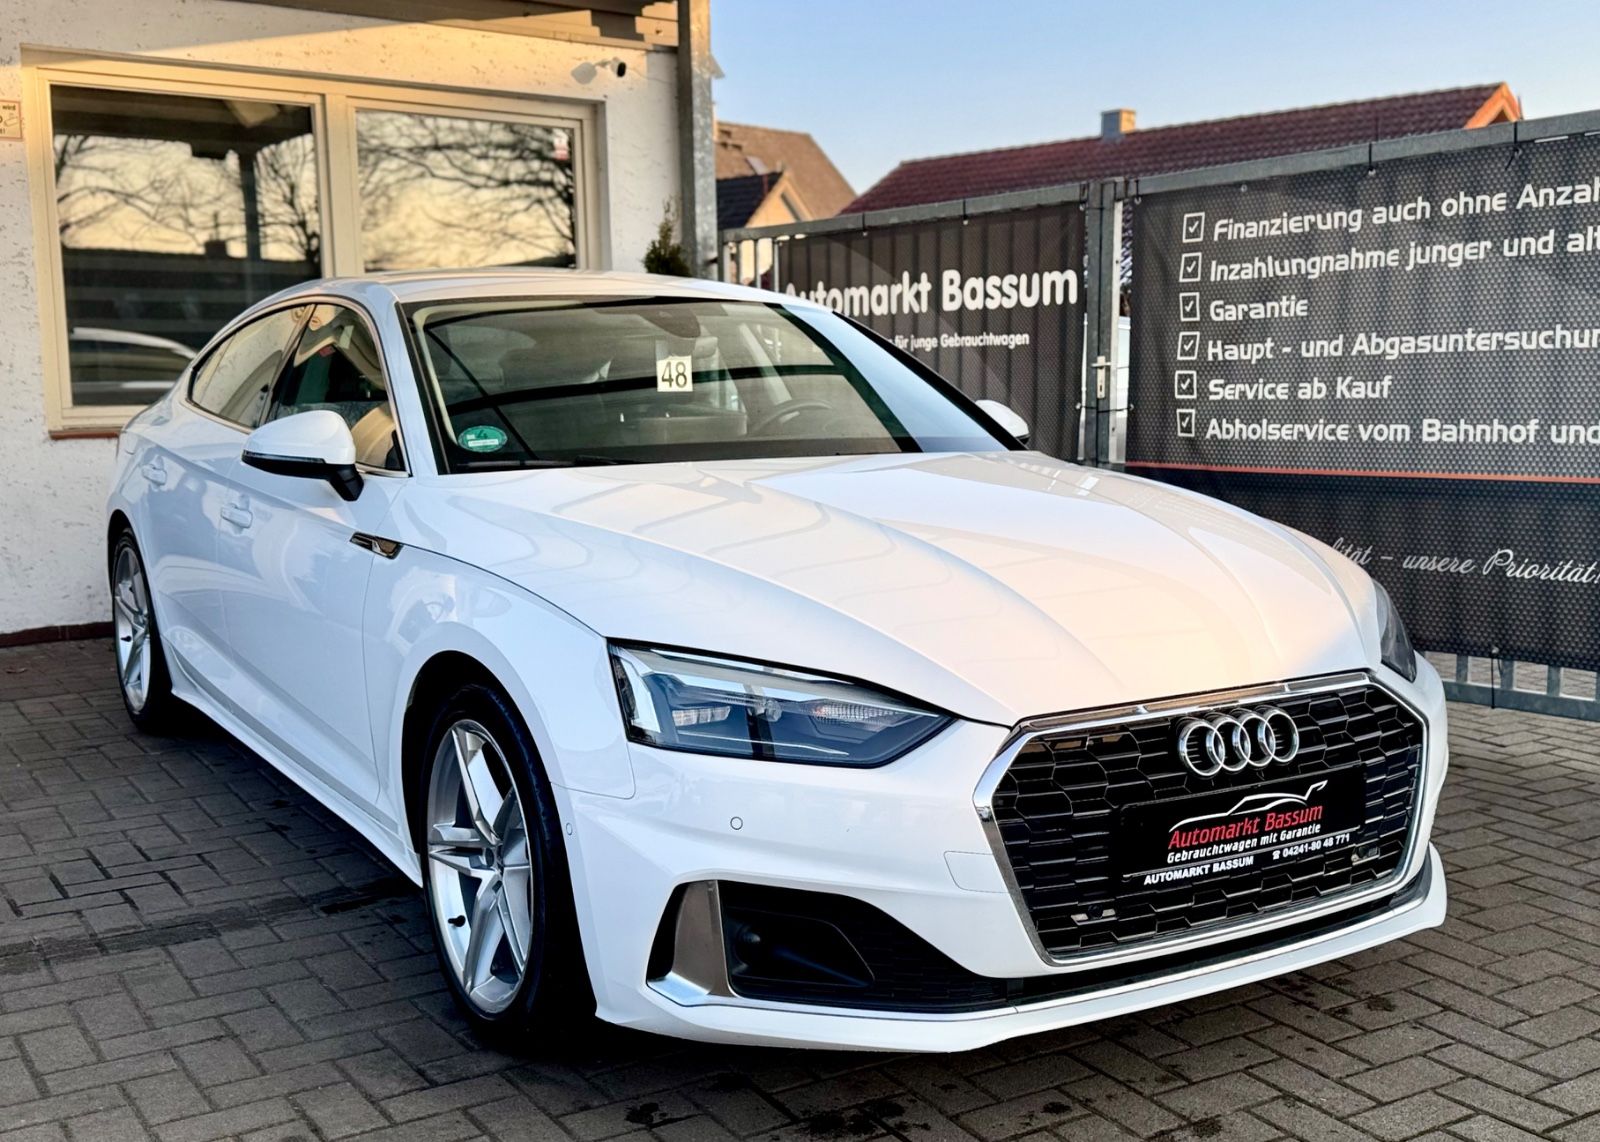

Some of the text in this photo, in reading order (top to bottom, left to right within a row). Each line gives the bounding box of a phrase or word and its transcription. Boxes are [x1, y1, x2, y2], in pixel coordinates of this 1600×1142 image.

[1213, 208, 1363, 241] Finanzierung
[1372, 196, 1431, 225] auch
[1441, 191, 1507, 217] ohne
[1210, 246, 1400, 282] Inzahlungnahme
[1405, 240, 1492, 270] junger
[1503, 229, 1555, 257] und
[942, 268, 1078, 312] Bassum
[1210, 294, 1309, 321] Garantie
[895, 332, 1030, 352] für junge Gebrauchtwagen
[1207, 336, 1275, 364] Haupt
[1301, 333, 1343, 358] und
[661, 361, 688, 388] 48
[1208, 375, 1393, 401] Service ab Kauf
[1206, 418, 1600, 444] Abholservice vom Bahnhof und
[1402, 554, 1477, 574] unsere
[1168, 805, 1324, 850] Automarkt Bassum
[1167, 823, 1321, 864] Gebrauchtwagen mit Garantie
[1282, 833, 1350, 858] 04241-80 48 771
[1144, 855, 1254, 886] AUTOMARKT BASSUM
